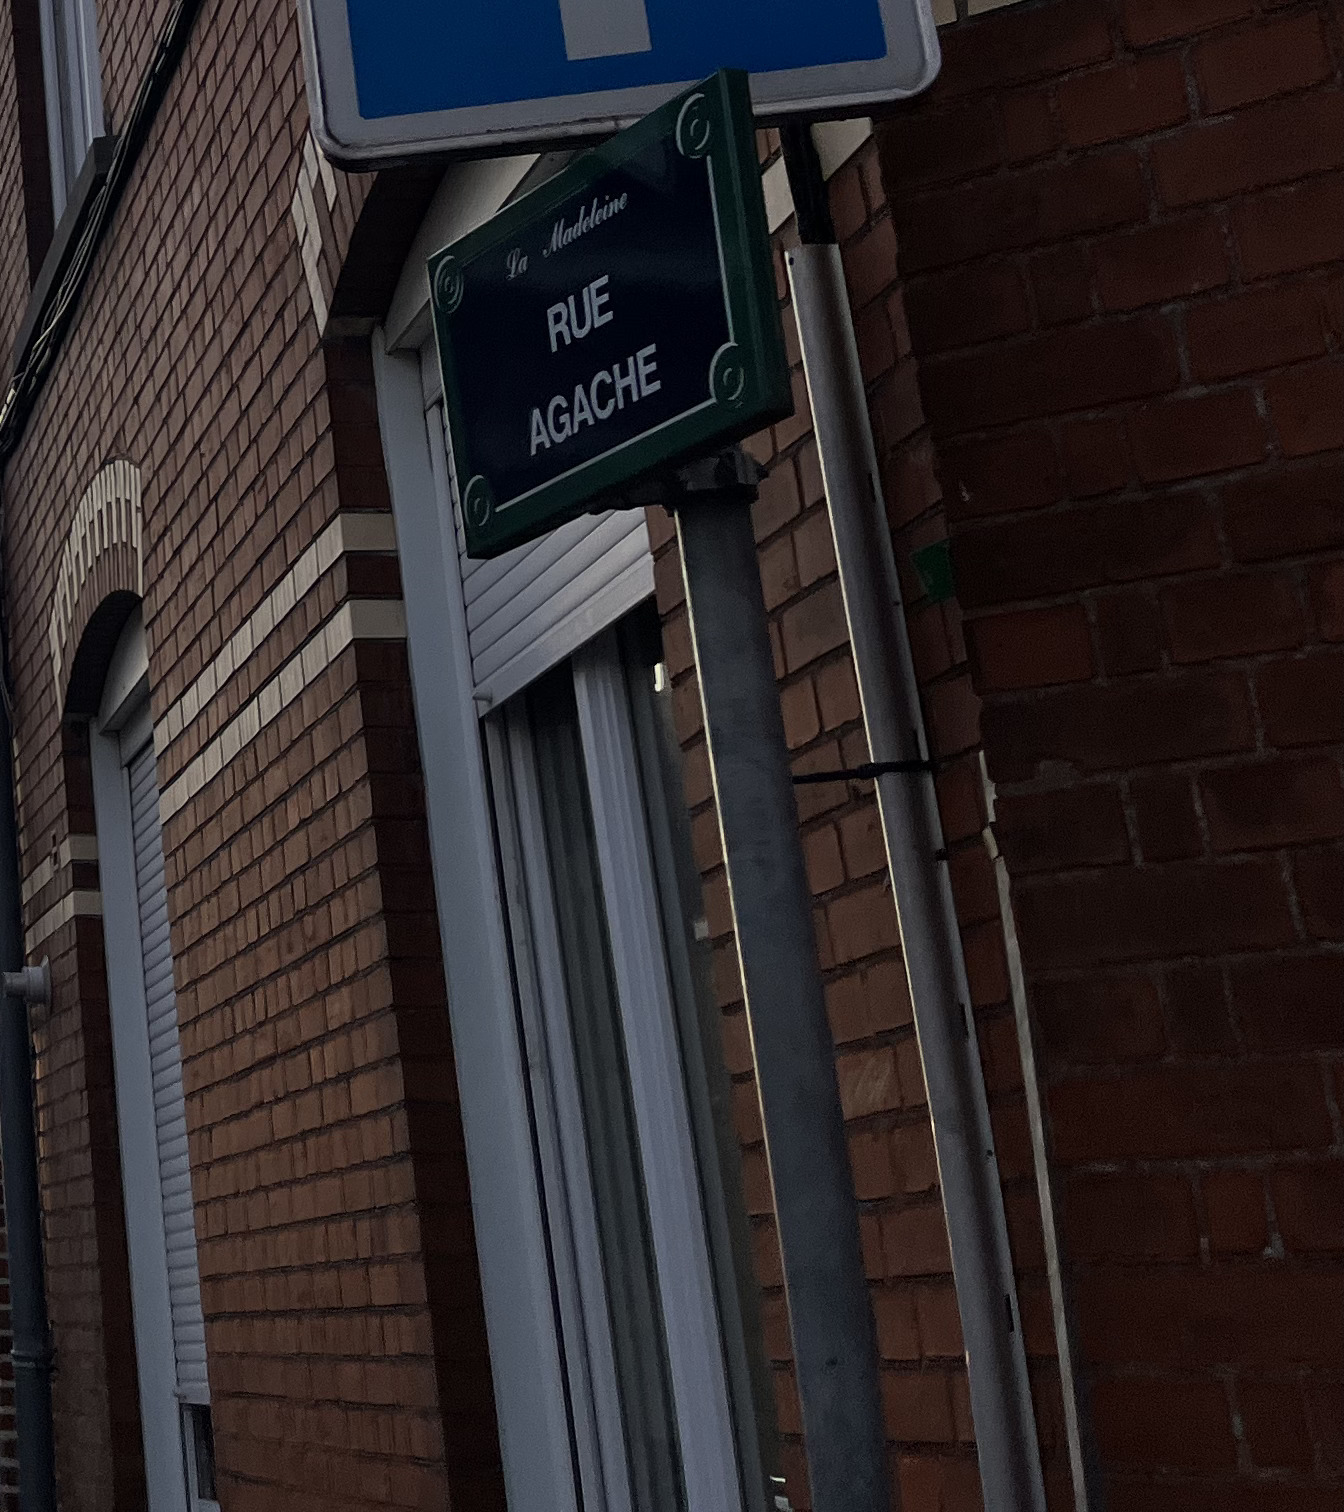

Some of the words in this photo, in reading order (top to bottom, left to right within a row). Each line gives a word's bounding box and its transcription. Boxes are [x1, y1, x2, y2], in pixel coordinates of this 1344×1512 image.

[504, 247, 529, 281] La
[542, 192, 628, 258] Madeleine
[546, 274, 613, 352] RUE
[529, 343, 661, 456] AGACHE
